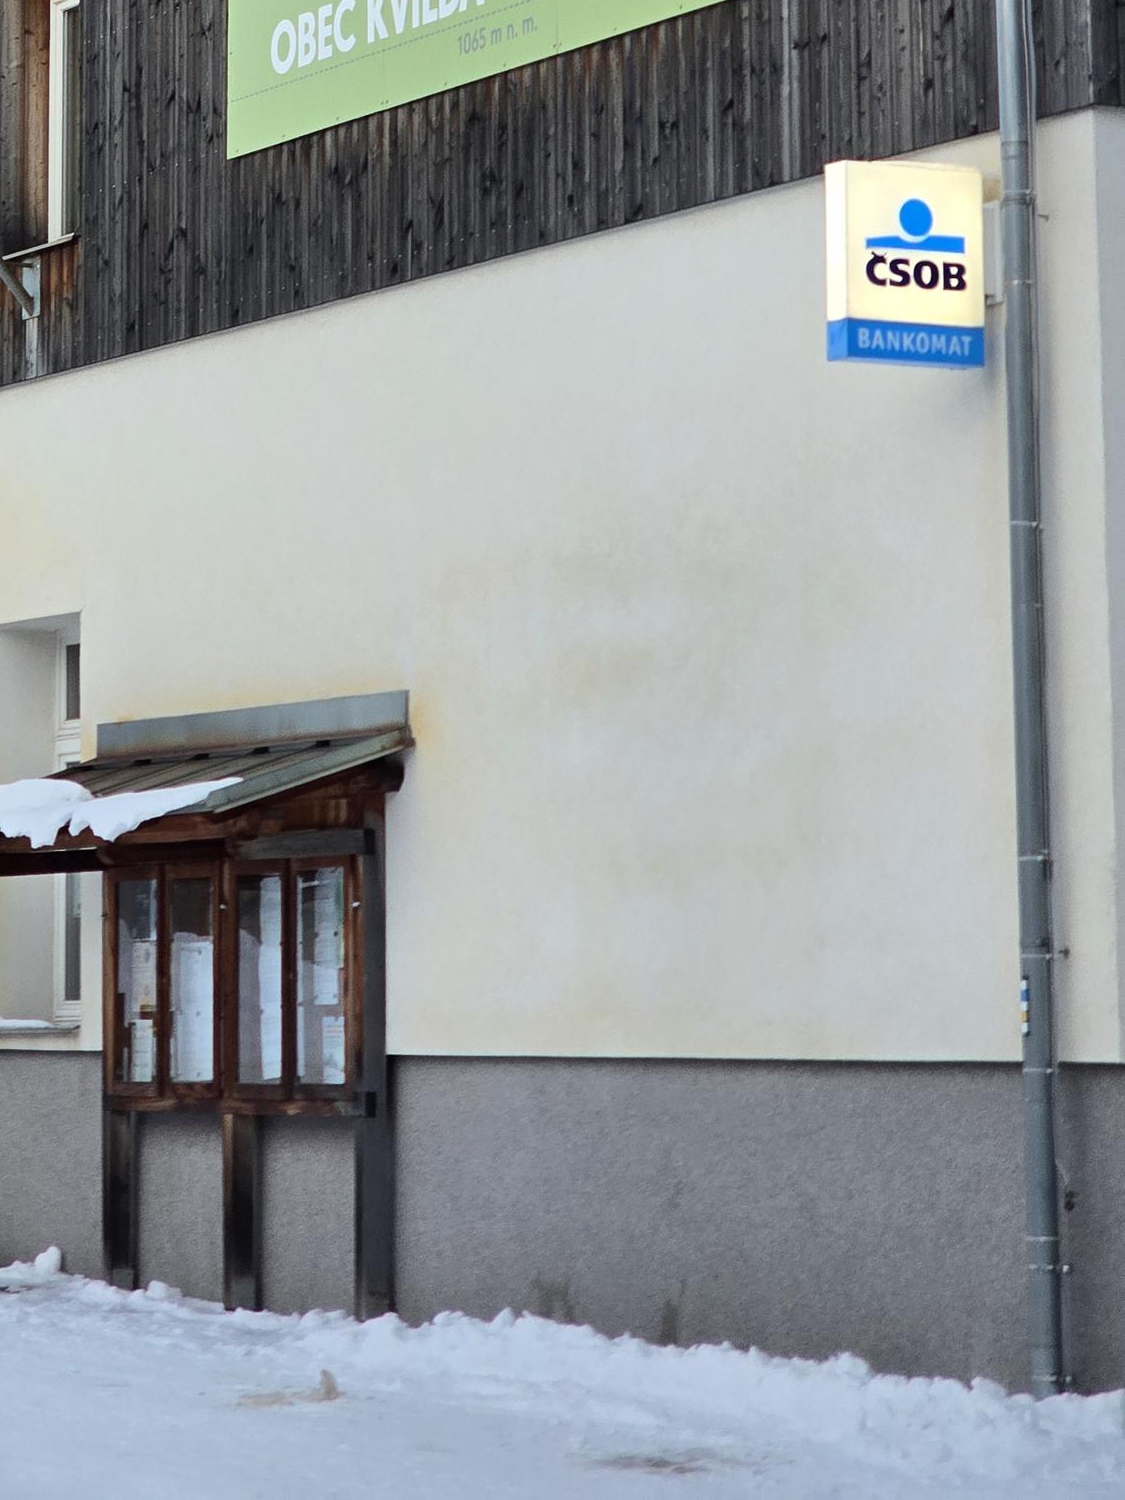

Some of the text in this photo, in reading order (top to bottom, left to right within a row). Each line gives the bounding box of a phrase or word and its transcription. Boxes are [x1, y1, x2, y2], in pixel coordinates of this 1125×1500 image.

[457, 16, 538, 56] 1065 m n. m.
[865, 251, 967, 291] ČSOB
[858, 328, 972, 356] BANKOMAT
